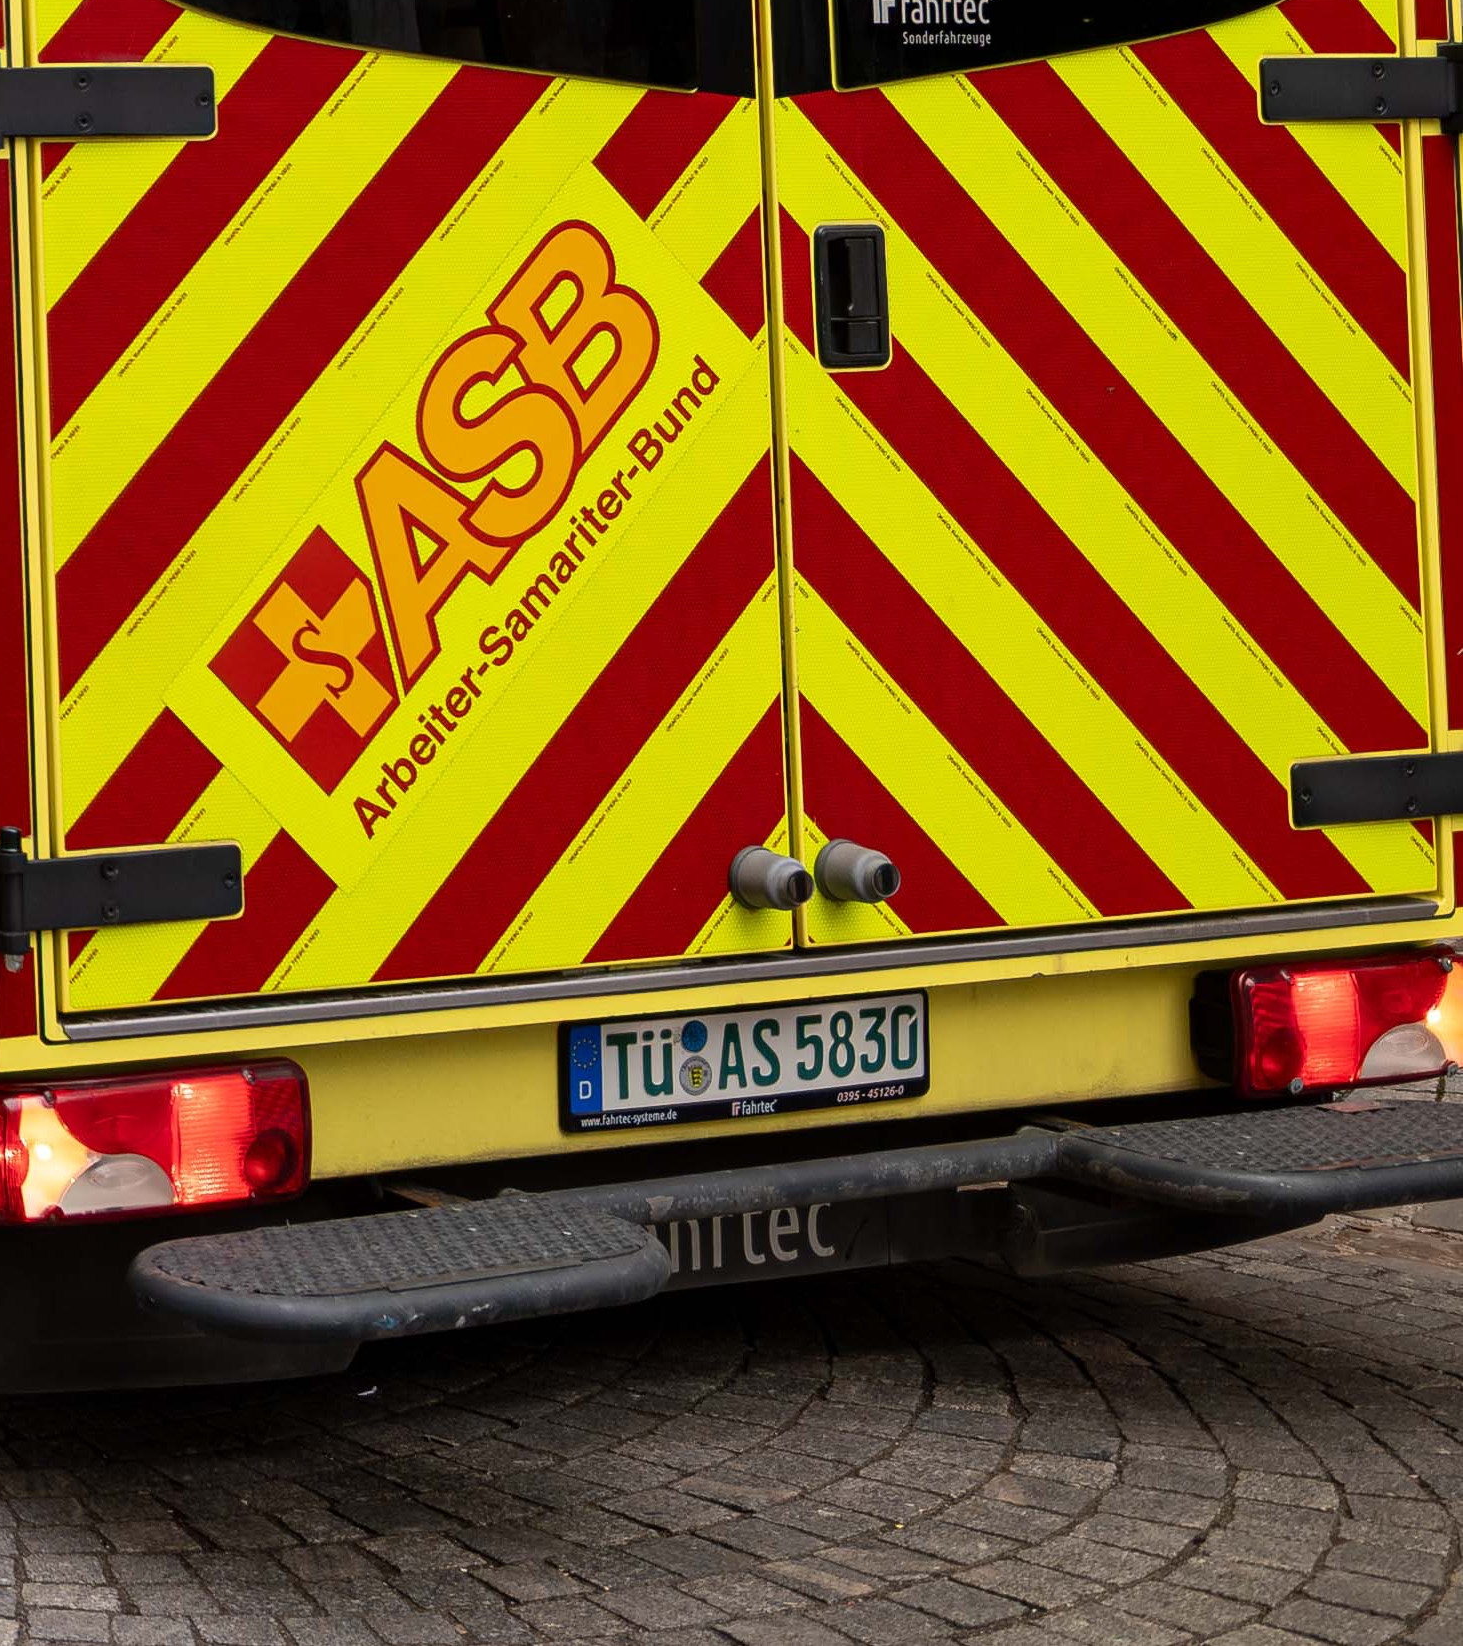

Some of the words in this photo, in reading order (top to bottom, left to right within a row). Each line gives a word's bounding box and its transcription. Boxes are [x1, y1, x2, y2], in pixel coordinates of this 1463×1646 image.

[902, 30, 992, 45] Sonderfahrzeuge
[354, 219, 660, 696] ASB
[351, 354, 721, 839] Arbeiter-Samariter-Bund
[606, 1028, 673, 1100] TÜ
[718, 1019, 782, 1091] AS
[796, 1004, 918, 1081] 5830
[579, 1080, 592, 1100] D
[837, 1090, 860, 1103] 0395
[867, 1085, 905, 1100] 45126-0
[580, 1109, 678, 1129] www.fahrtec-systeme.de
